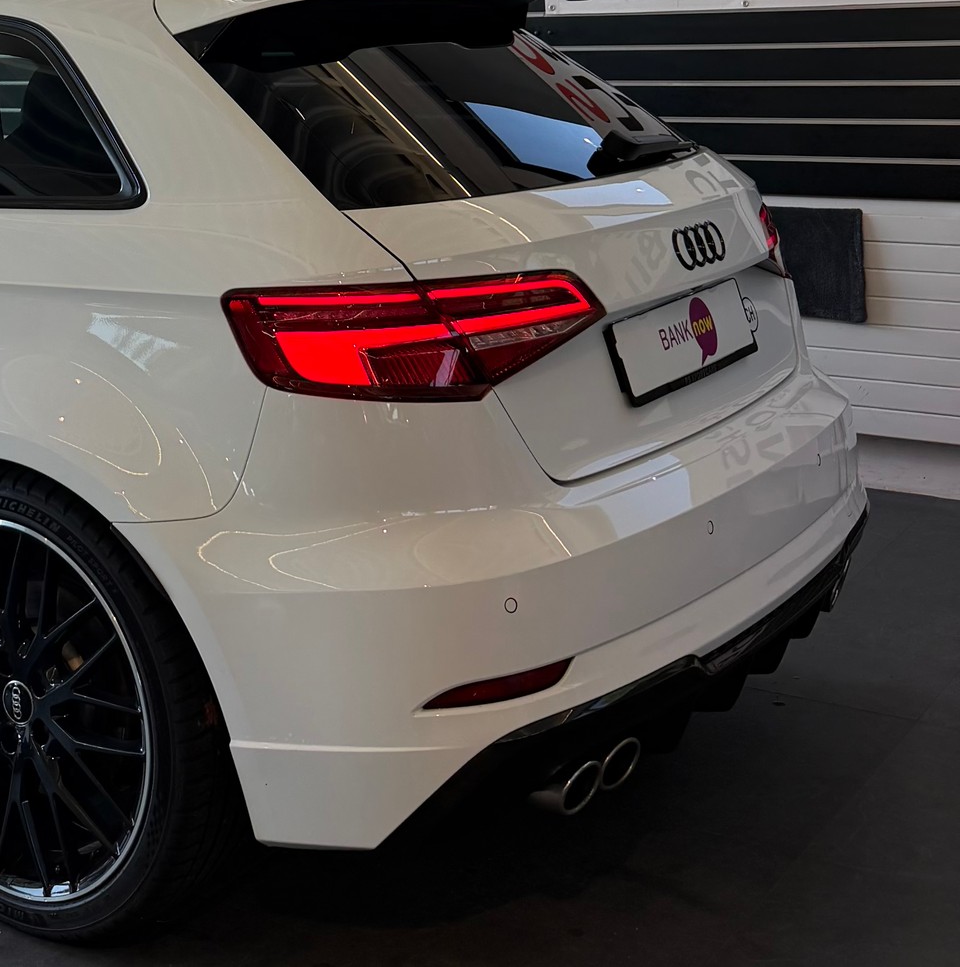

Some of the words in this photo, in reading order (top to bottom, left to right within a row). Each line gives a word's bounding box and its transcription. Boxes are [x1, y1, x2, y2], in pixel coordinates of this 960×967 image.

[743, 304, 756, 323] CH
[658, 319, 694, 351] BANK
[692, 315, 713, 337] now
